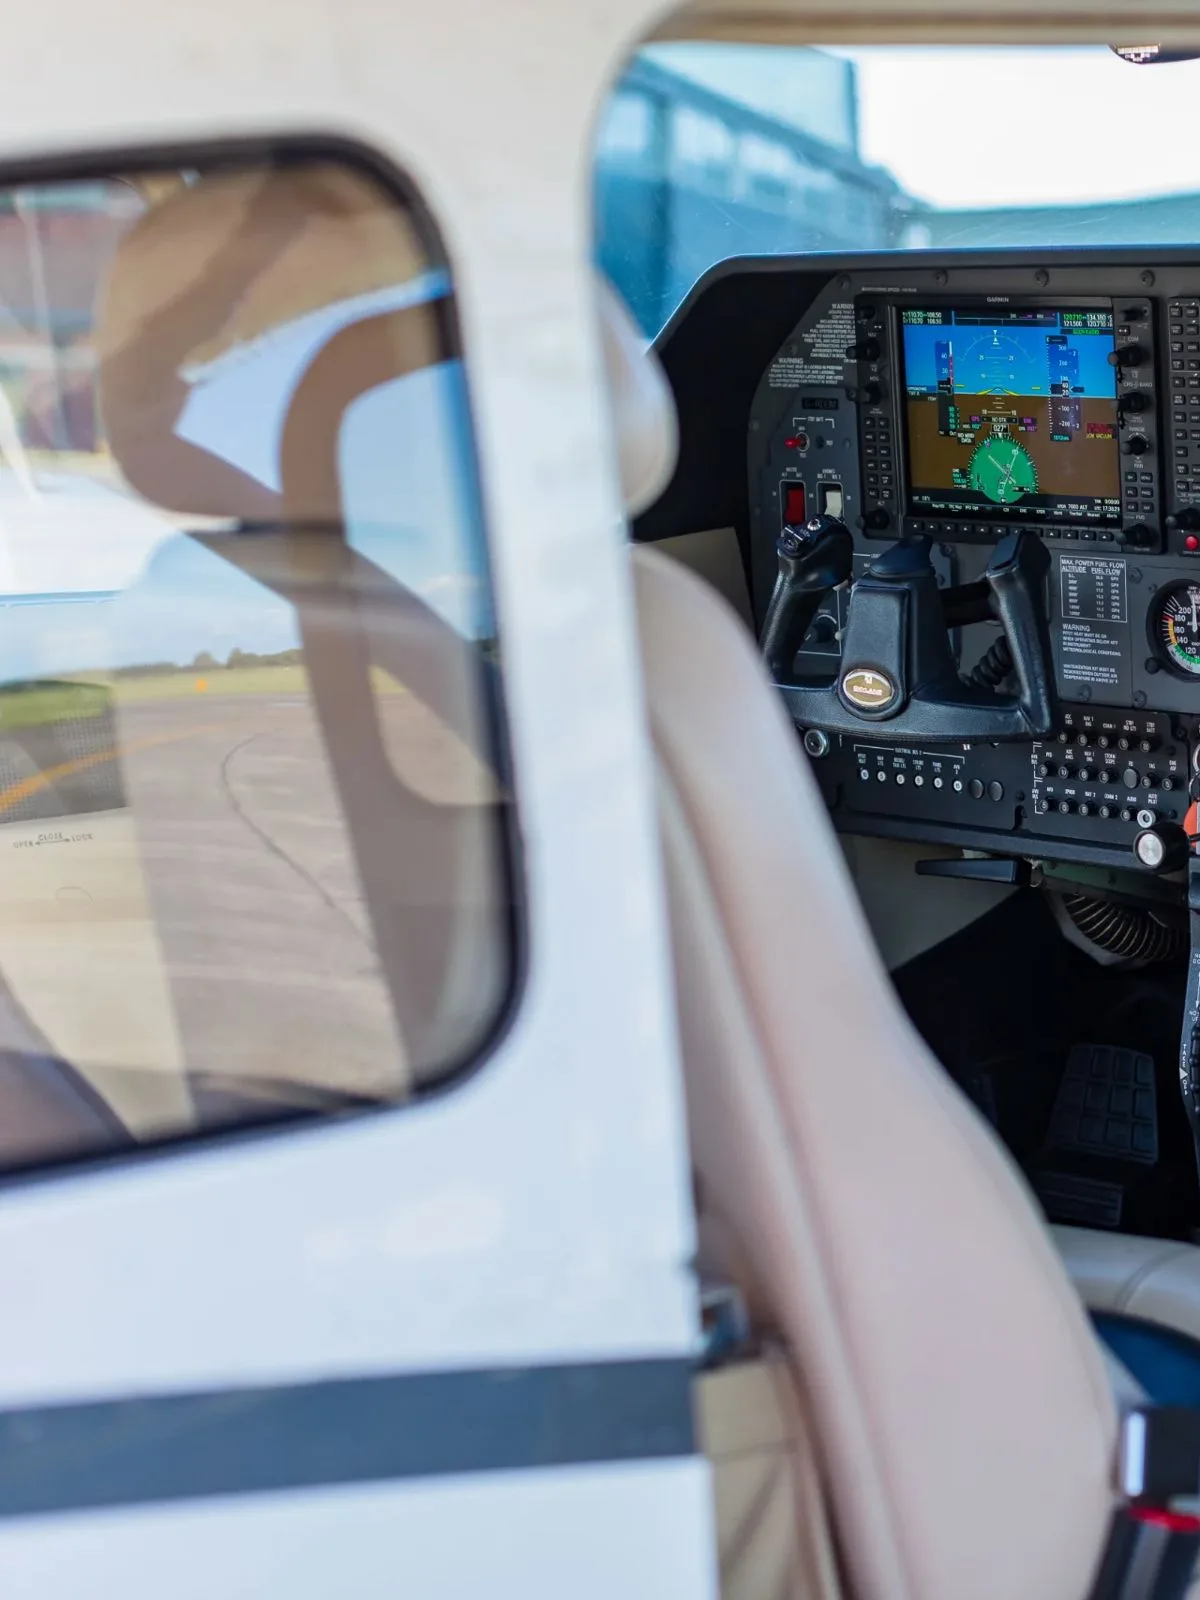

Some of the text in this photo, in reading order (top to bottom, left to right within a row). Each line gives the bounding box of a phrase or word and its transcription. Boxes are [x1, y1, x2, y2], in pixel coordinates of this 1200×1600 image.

[1061, 565, 1087, 573] ALTITUDE
[1091, 567, 1104, 575] FUEL
[1178, 606, 1191, 614] 200
[1062, 623, 1090, 632] WARNING
